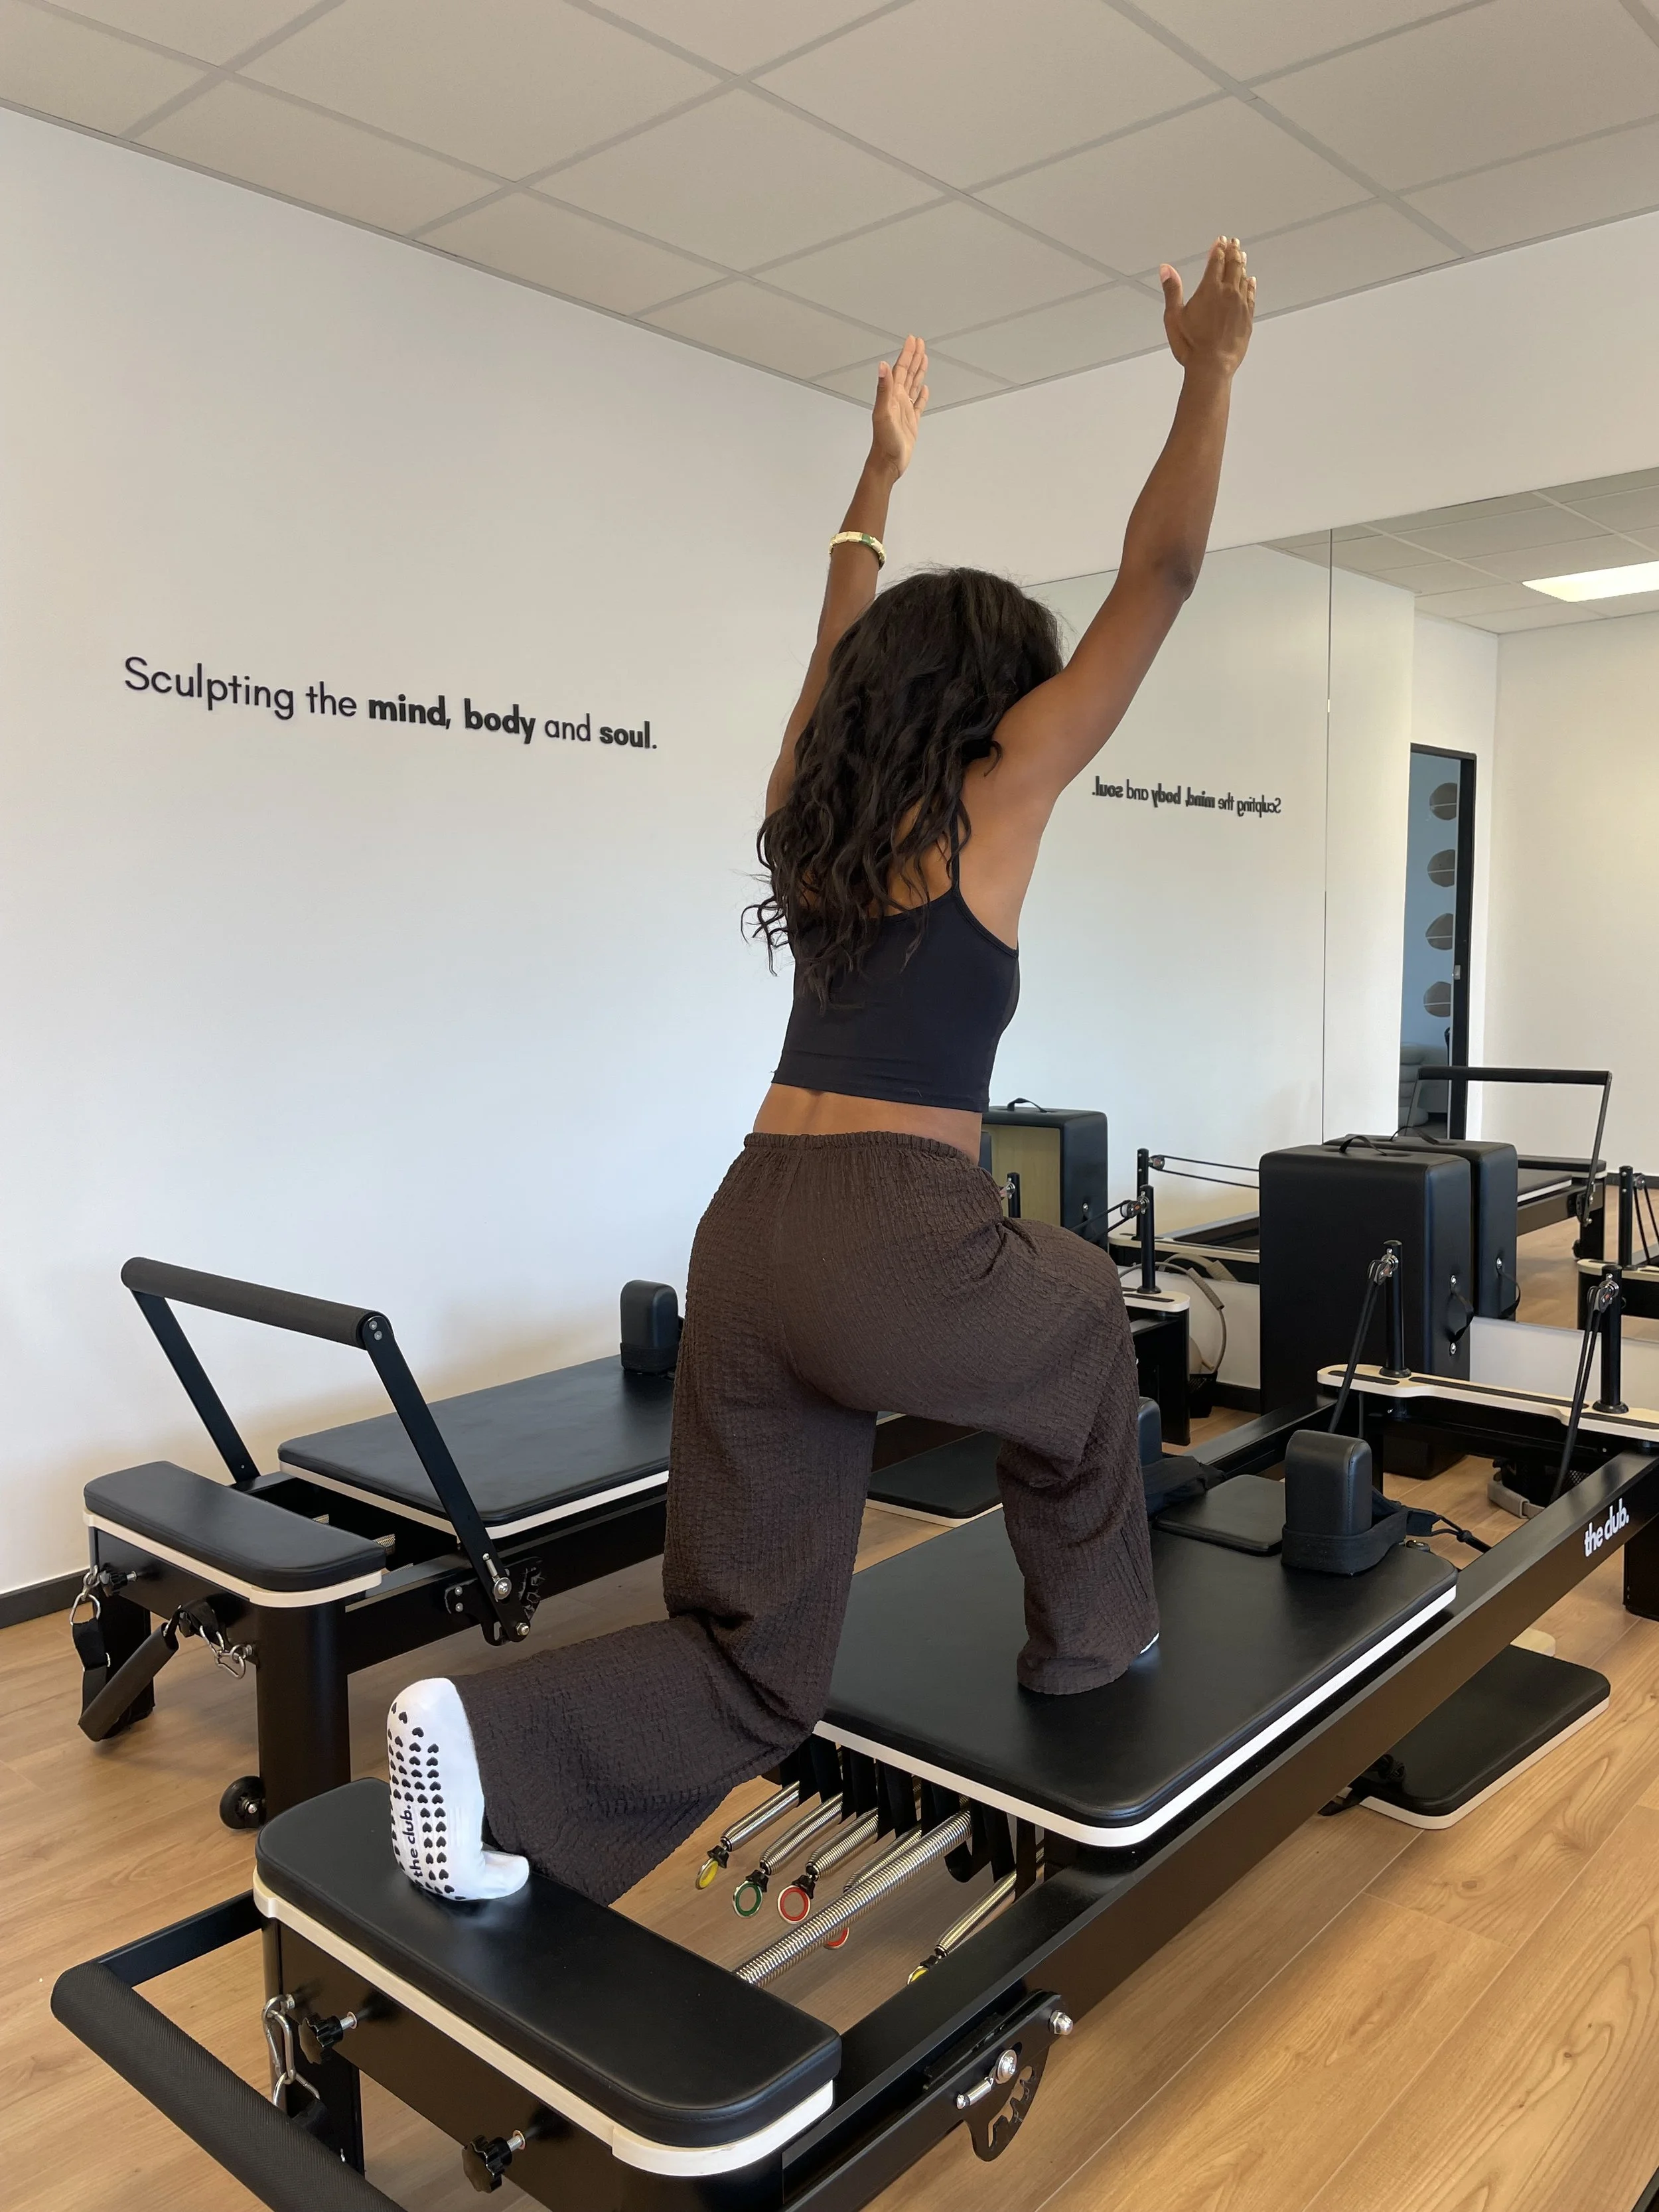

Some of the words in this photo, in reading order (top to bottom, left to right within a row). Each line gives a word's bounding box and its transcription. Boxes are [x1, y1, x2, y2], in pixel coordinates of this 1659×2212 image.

[125, 656, 294, 721] Sculpting
[305, 681, 357, 717] the
[368, 694, 451, 730] mind,
[464, 698, 536, 745] body
[544, 713, 591, 742] and
[599, 721, 657, 749] soul.
[1584, 1522, 1604, 1557] the
[399, 1805, 415, 1844] club.
[409, 1848, 423, 1878] the
